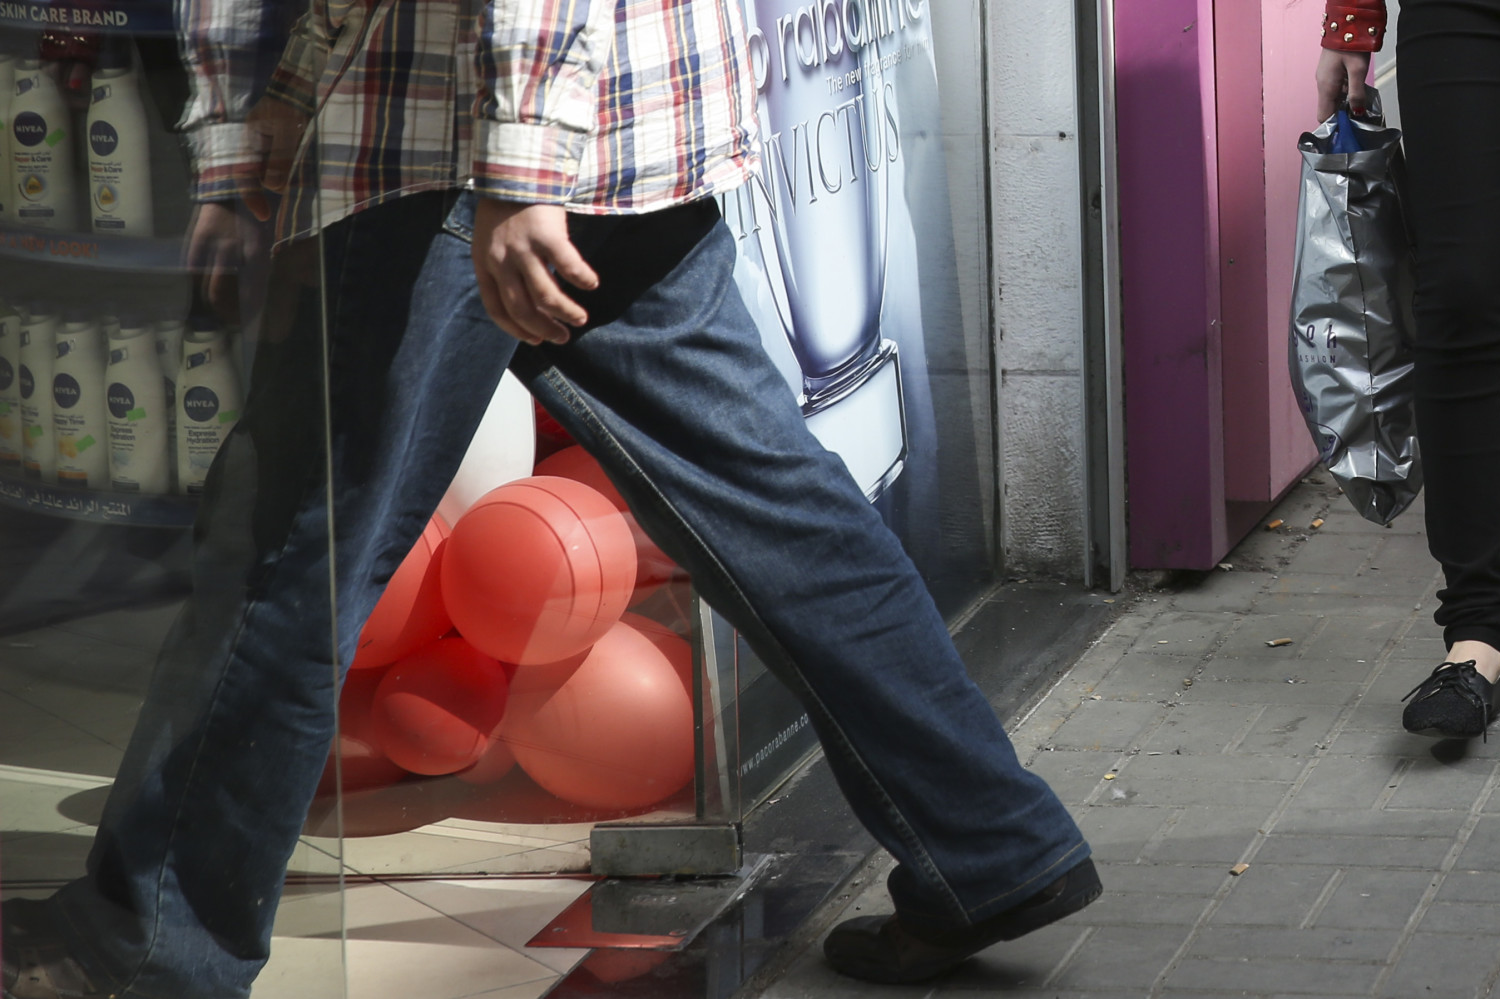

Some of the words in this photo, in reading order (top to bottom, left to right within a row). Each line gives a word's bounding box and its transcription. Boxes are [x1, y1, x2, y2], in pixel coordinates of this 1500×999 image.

[0, 2, 27, 19] SKIN
[31, 6, 68, 24] CARE
[72, 9, 128, 26] BRAND
[827, 74, 843, 96] The
[845, 66, 862, 87] new
[864, 51, 901, 79] fragrance
[16, 125, 44, 133] NIVEA
[91, 135, 115, 143] NIVEA
[186, 400, 215, 408] NIVEA
